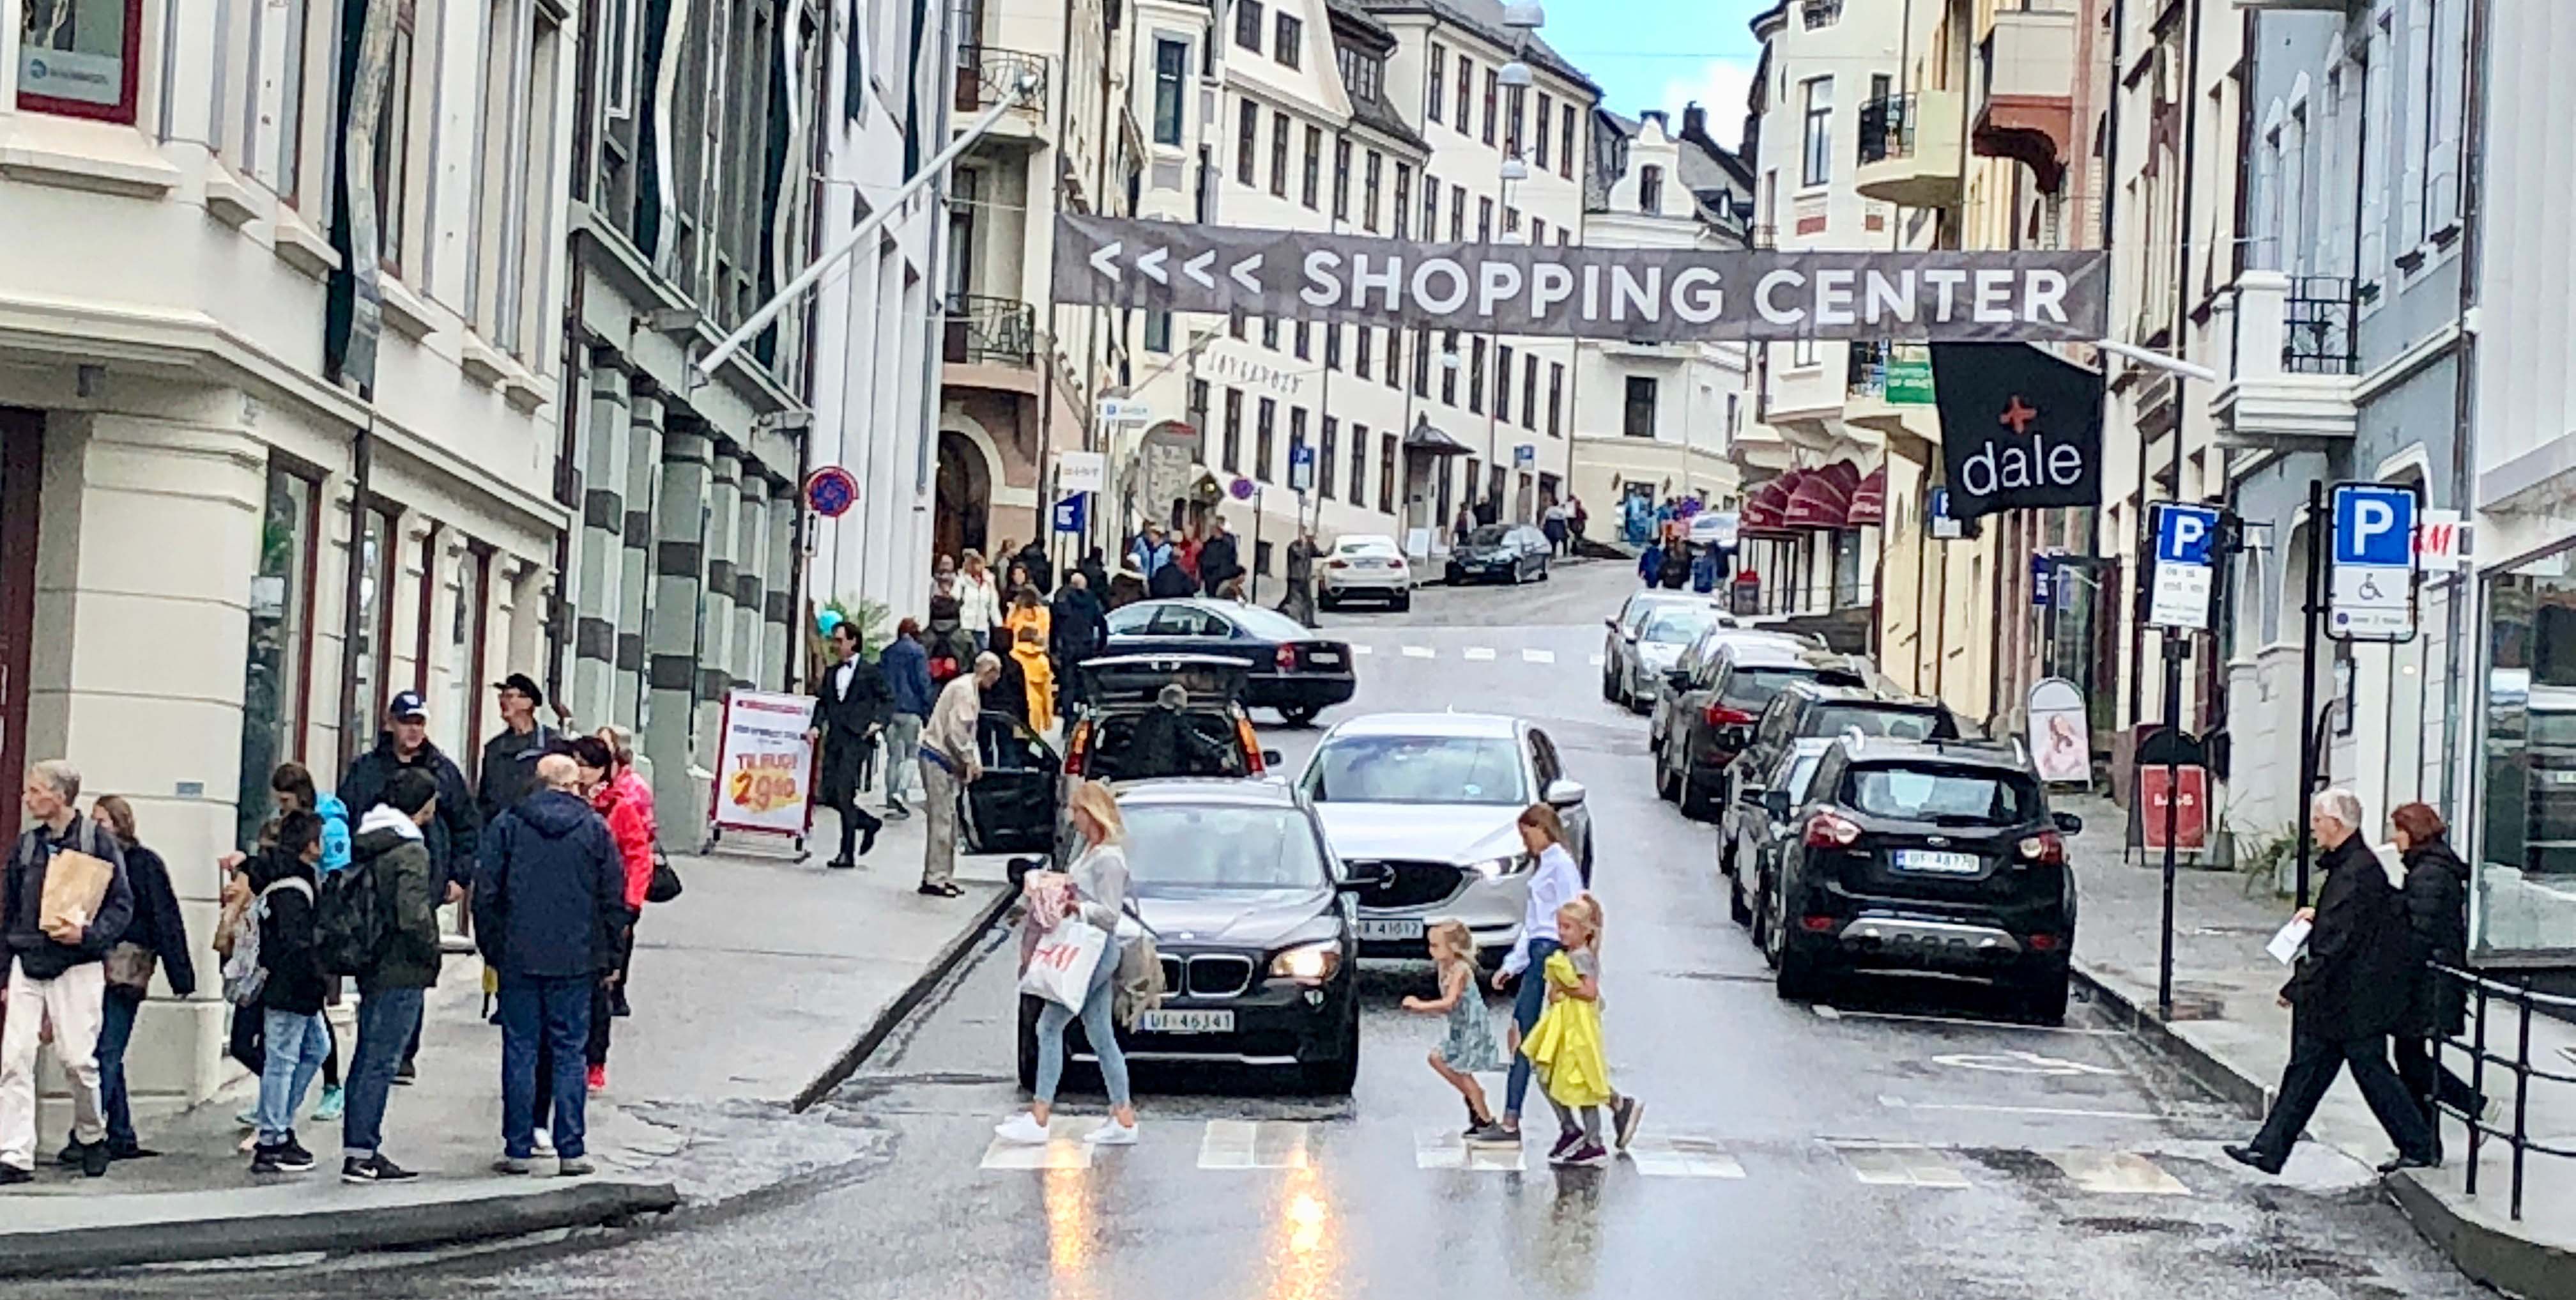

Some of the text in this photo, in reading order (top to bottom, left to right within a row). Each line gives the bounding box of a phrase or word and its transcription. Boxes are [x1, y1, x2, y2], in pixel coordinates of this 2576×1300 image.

[1300, 250, 2069, 325] SHOPPING CENTER
[1962, 433, 2082, 496] dale
[2172, 515, 2205, 558] P
[2353, 499, 2395, 556] P
